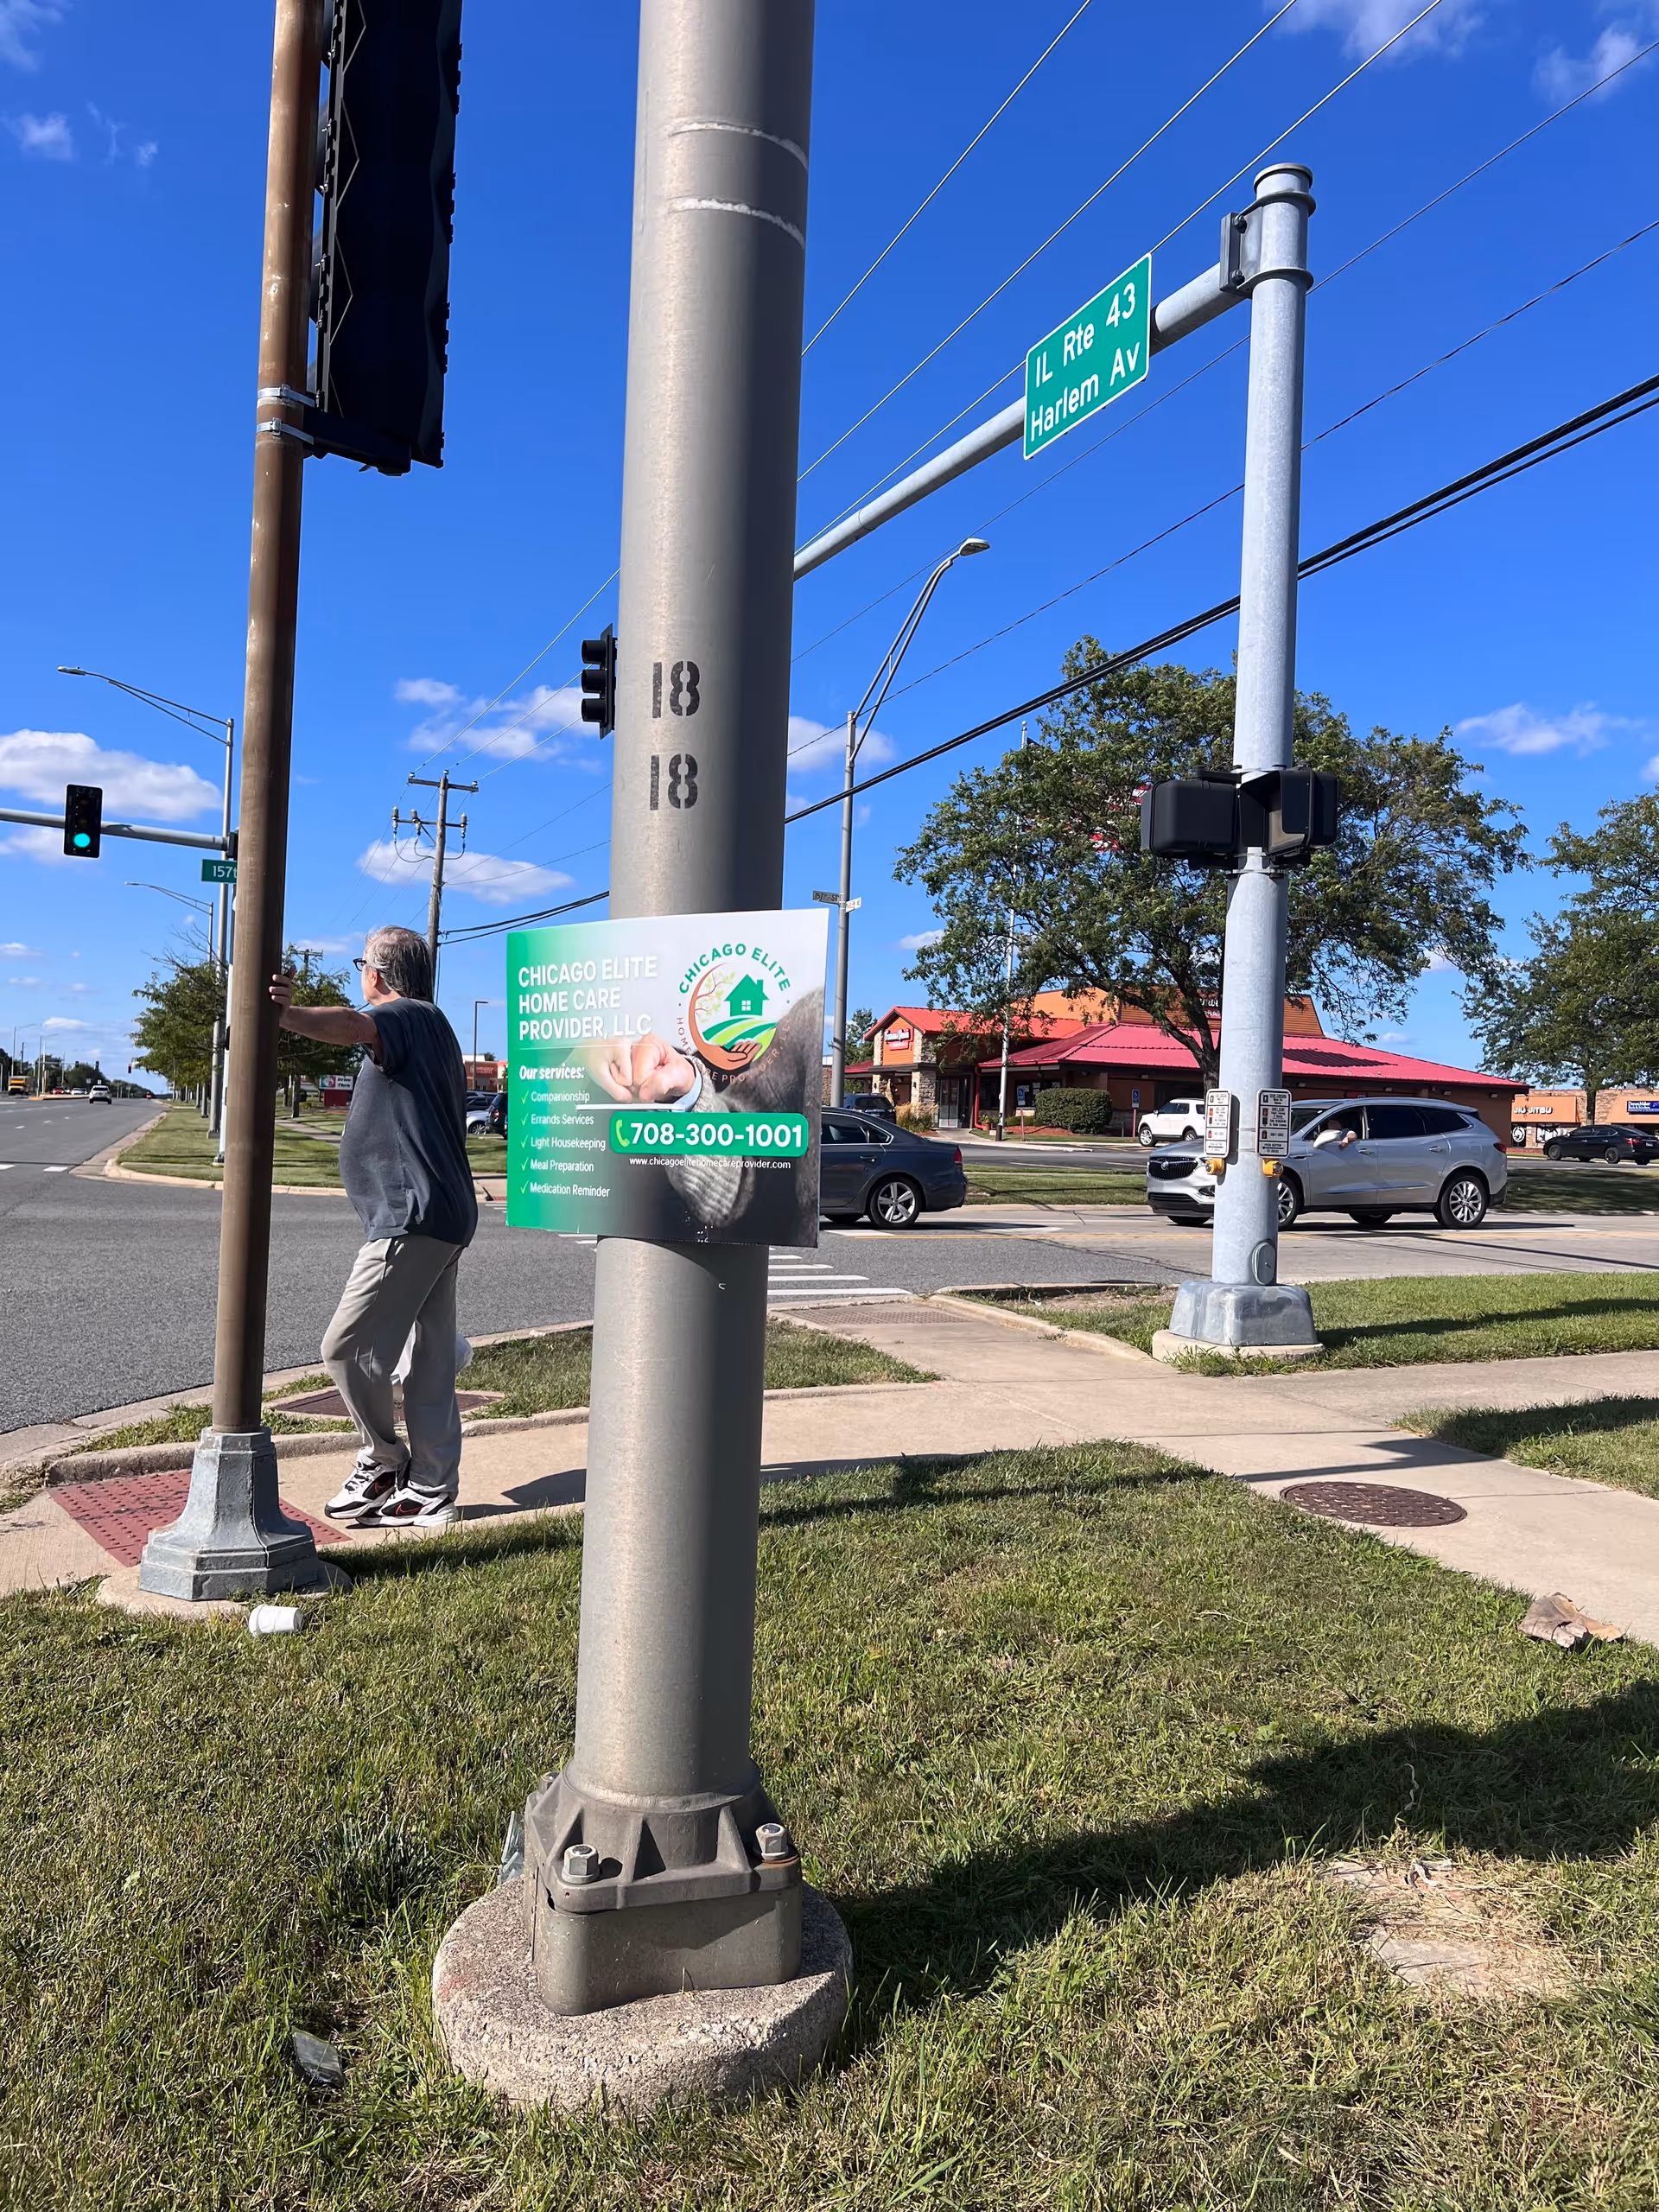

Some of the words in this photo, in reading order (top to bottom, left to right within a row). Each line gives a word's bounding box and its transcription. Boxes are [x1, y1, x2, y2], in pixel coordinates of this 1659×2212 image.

[1036, 351, 1053, 388] IL
[1063, 322, 1095, 366] Rte
[1105, 282, 1135, 327] 43
[1030, 373, 1099, 442] Harlem
[1109, 341, 1141, 387] Av
[652, 660, 700, 718] 18
[650, 753, 698, 810] 18
[518, 960, 597, 988] CHICAGO
[601, 955, 658, 981] ELITE
[678, 943, 747, 994] CHICAGO
[751, 947, 791, 992] ELITE
[519, 990, 569, 1014] HOME
[573, 986, 621, 1011] CARE
[519, 1015, 607, 1040] PROVIDER,
[613, 1014, 652, 1036] LLC
[677, 1017, 692, 1054] HOME
[519, 1065, 538, 1080] Our
[538, 1063, 585, 1079] services:
[531, 1090, 590, 1103] Companionship
[531, 1113, 560, 1125] Errands
[562, 1113, 594, 1125] Services
[531, 1137, 550, 1149] Light
[551, 1137, 606, 1151] Housekeeping
[630, 1122, 802, 1147] 708-300-1001
[531, 1159, 548, 1170] Meal
[550, 1160, 594, 1173] Preparation
[629, 1156, 791, 1169] www.chicagoelitehomecareprovider.com
[530, 1182, 570, 1195] Medication
[572, 1184, 611, 1198] Reminder
